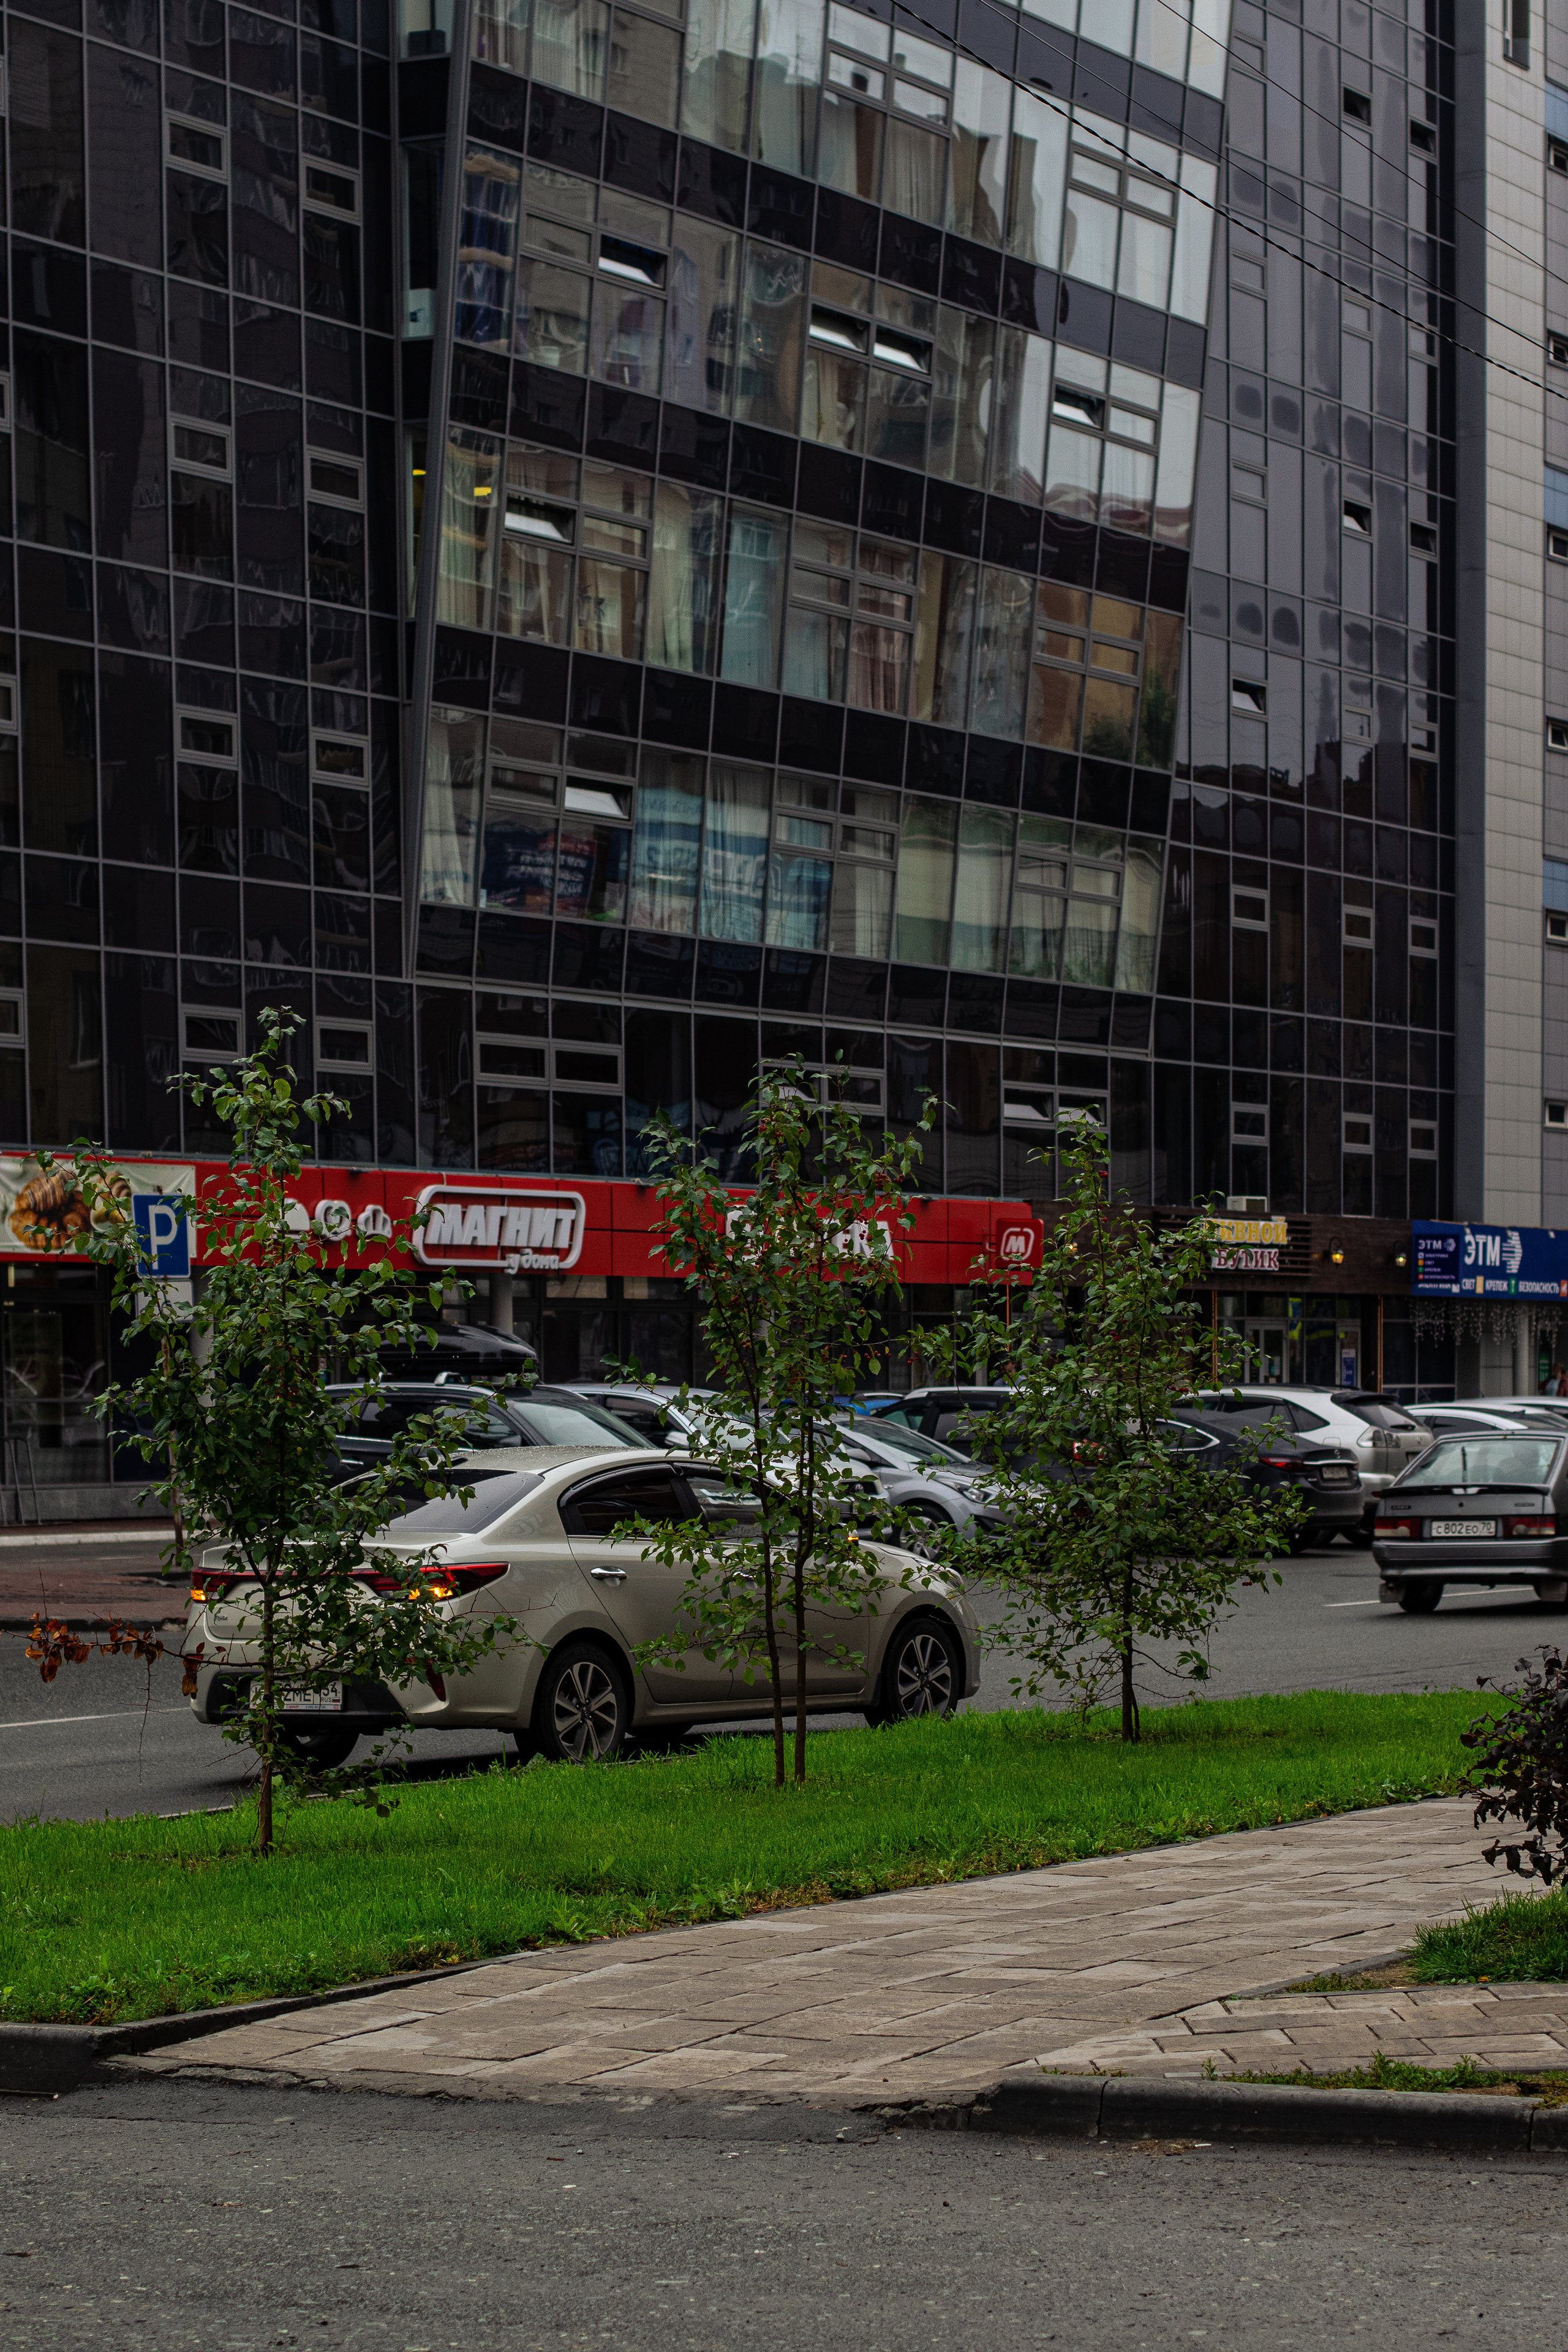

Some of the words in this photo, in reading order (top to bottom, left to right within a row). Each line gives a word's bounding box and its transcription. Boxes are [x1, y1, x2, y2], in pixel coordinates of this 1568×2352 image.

[148, 1204, 178, 1270] P
[424, 1203, 576, 1249] МАГНИТ
[520, 1248, 560, 1270] дома
[1418, 1239, 1442, 1250] ЭТМ
[1464, 1235, 1501, 1267] ЭТМ
